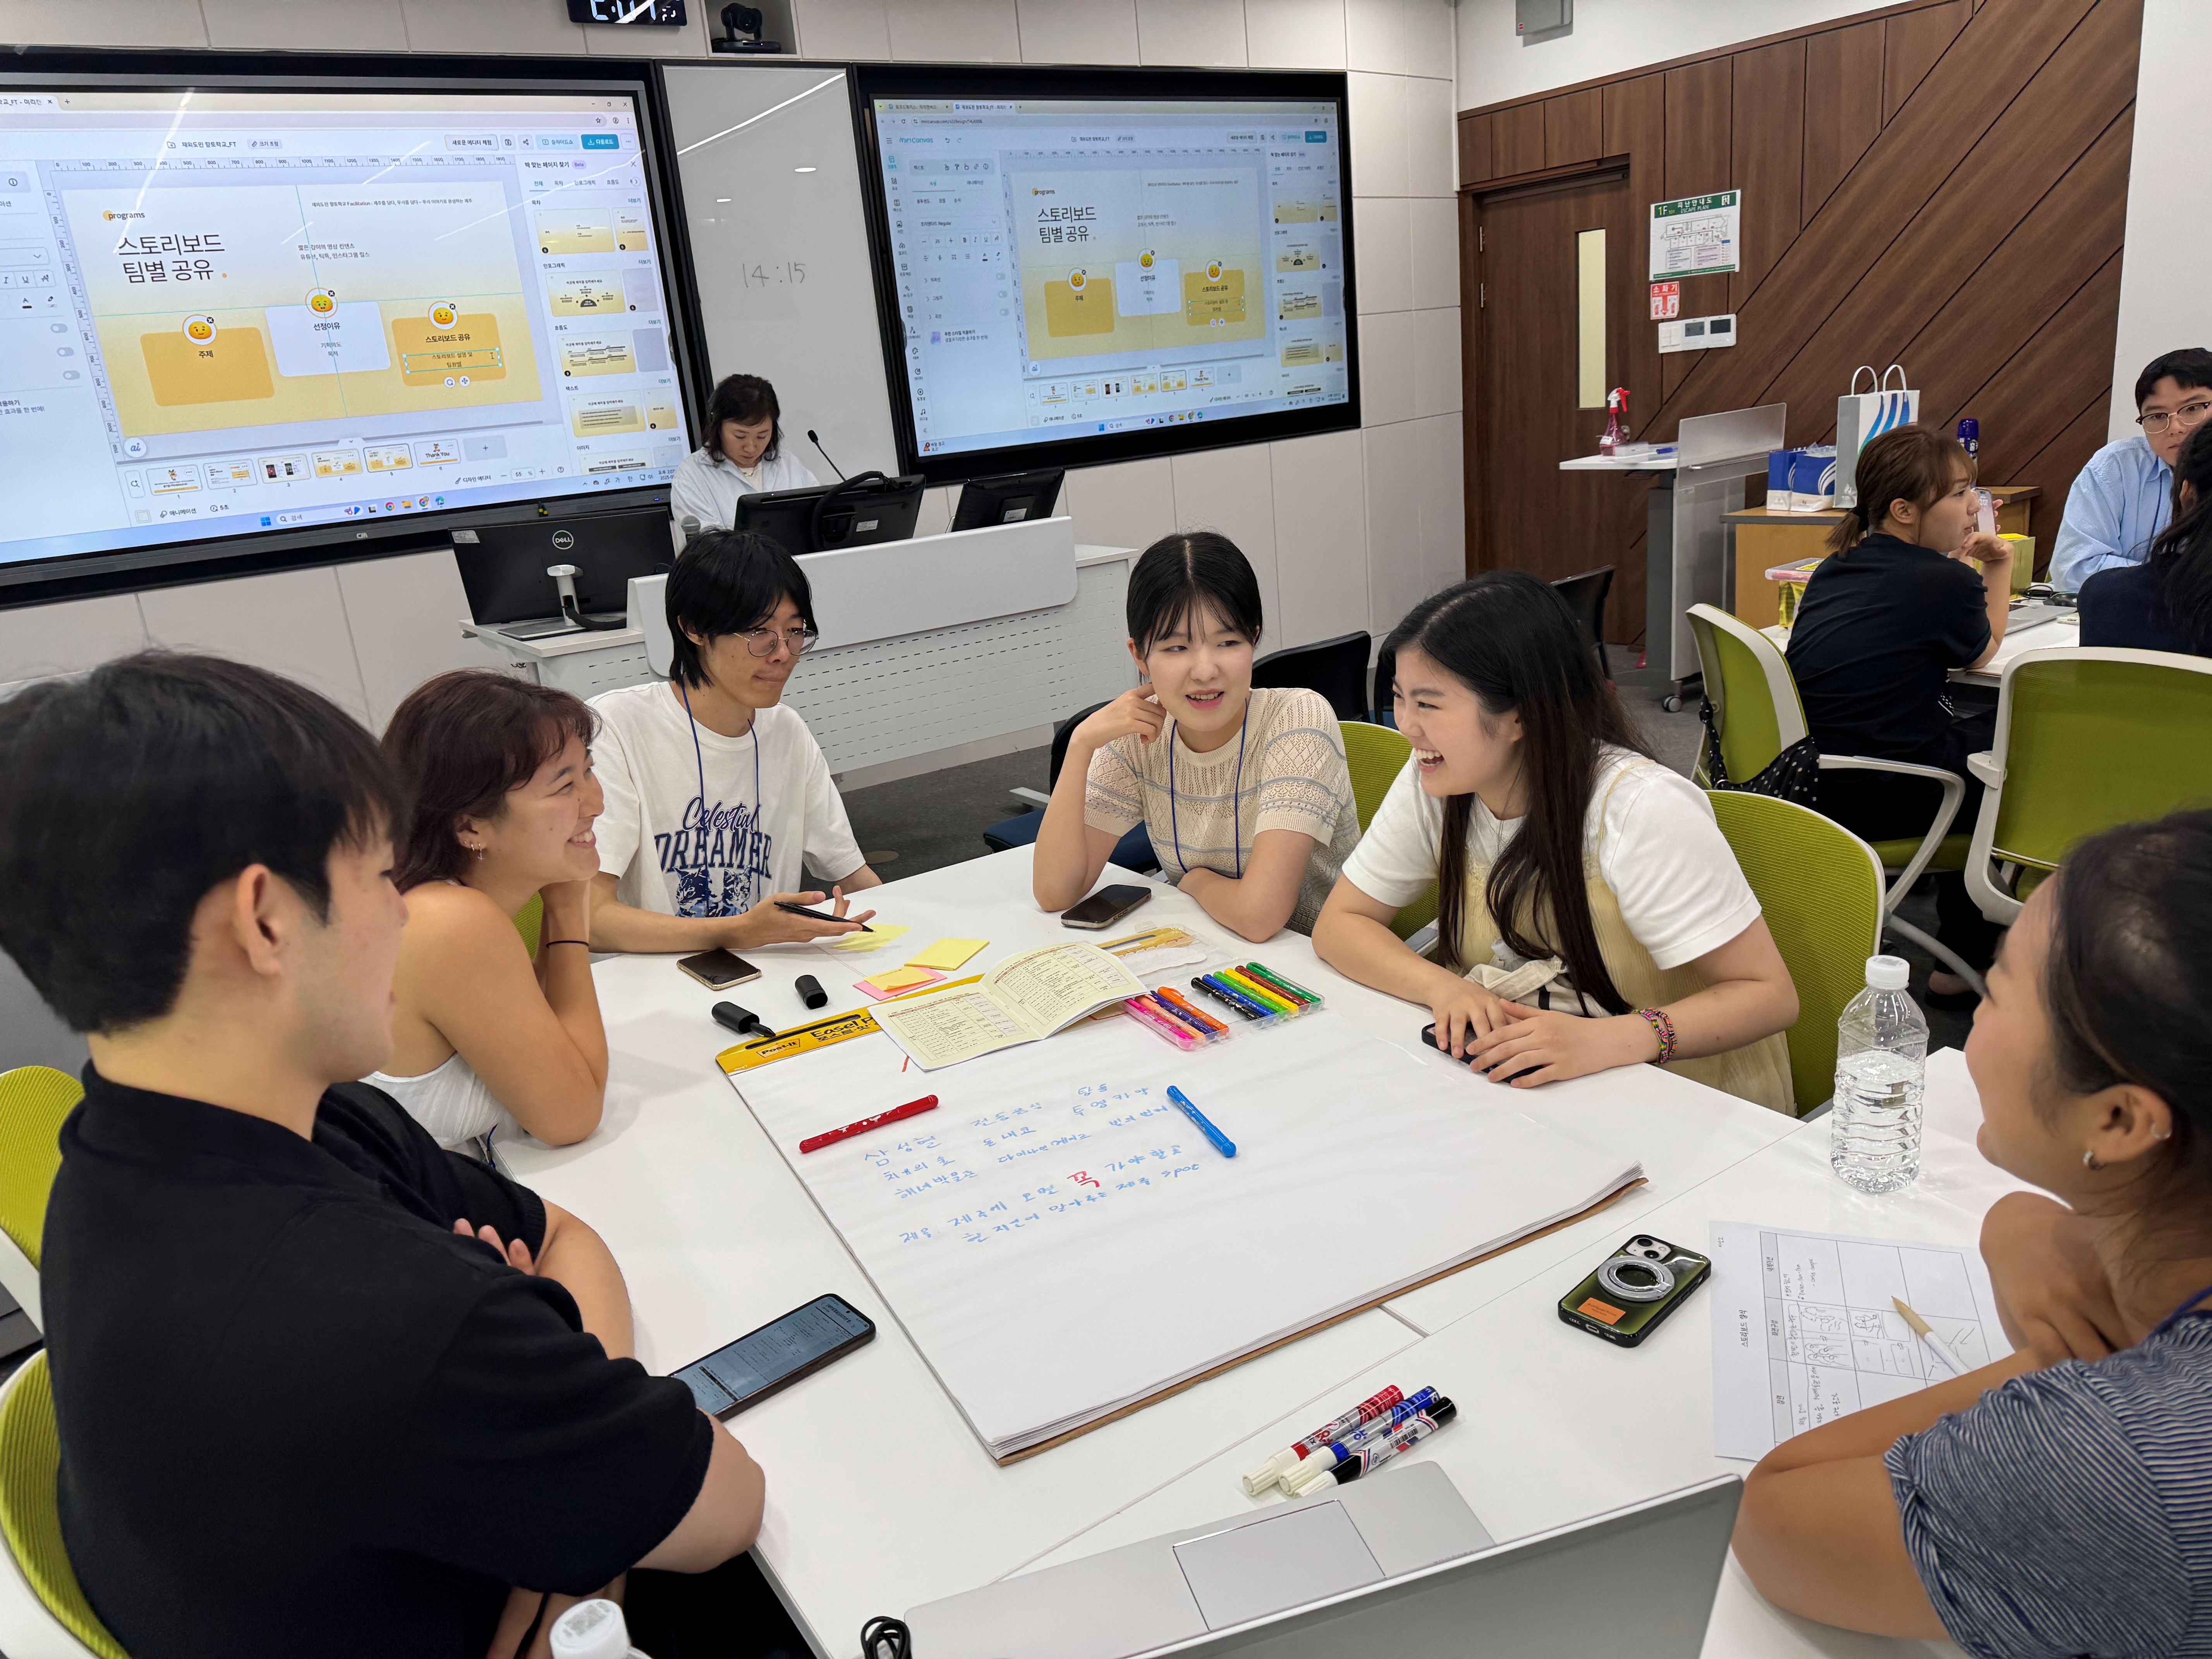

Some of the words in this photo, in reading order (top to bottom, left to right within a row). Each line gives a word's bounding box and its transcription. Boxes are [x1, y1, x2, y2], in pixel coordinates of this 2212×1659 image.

[108, 211, 145, 220] programs
[1038, 206, 1097, 223] 스토리보드
[1658, 206, 1668, 216] 1F
[1040, 226, 1063, 243] 팀별
[1066, 225, 1089, 242] 공유
[118, 234, 225, 258] 스토리보드
[124, 260, 167, 284] 팀별
[172, 259, 214, 282] 공유
[743, 262, 805, 288] 14:15
[1653, 283, 1678, 293] 소화기
[313, 322, 340, 331] 선정이유
[198, 350, 213, 359] 주제
[131, 443, 141, 452] ai
[169, 508, 197, 516] 애니메이션
[681, 795, 762, 833] Celestial
[654, 828, 772, 880] DREAMER
[810, 1022, 859, 1038] Easel
[1072, 1087, 1148, 1116] 투명카약
[865, 1135, 942, 1167] 삼성혈
[1161, 1164, 1200, 1178] spot
[947, 1201, 1008, 1226] 제주에
[1022, 1184, 1059, 1202] 오면
[1066, 1170, 1101, 1188] 꼭
[1740, 1322, 1749, 1348] 스토리보드
